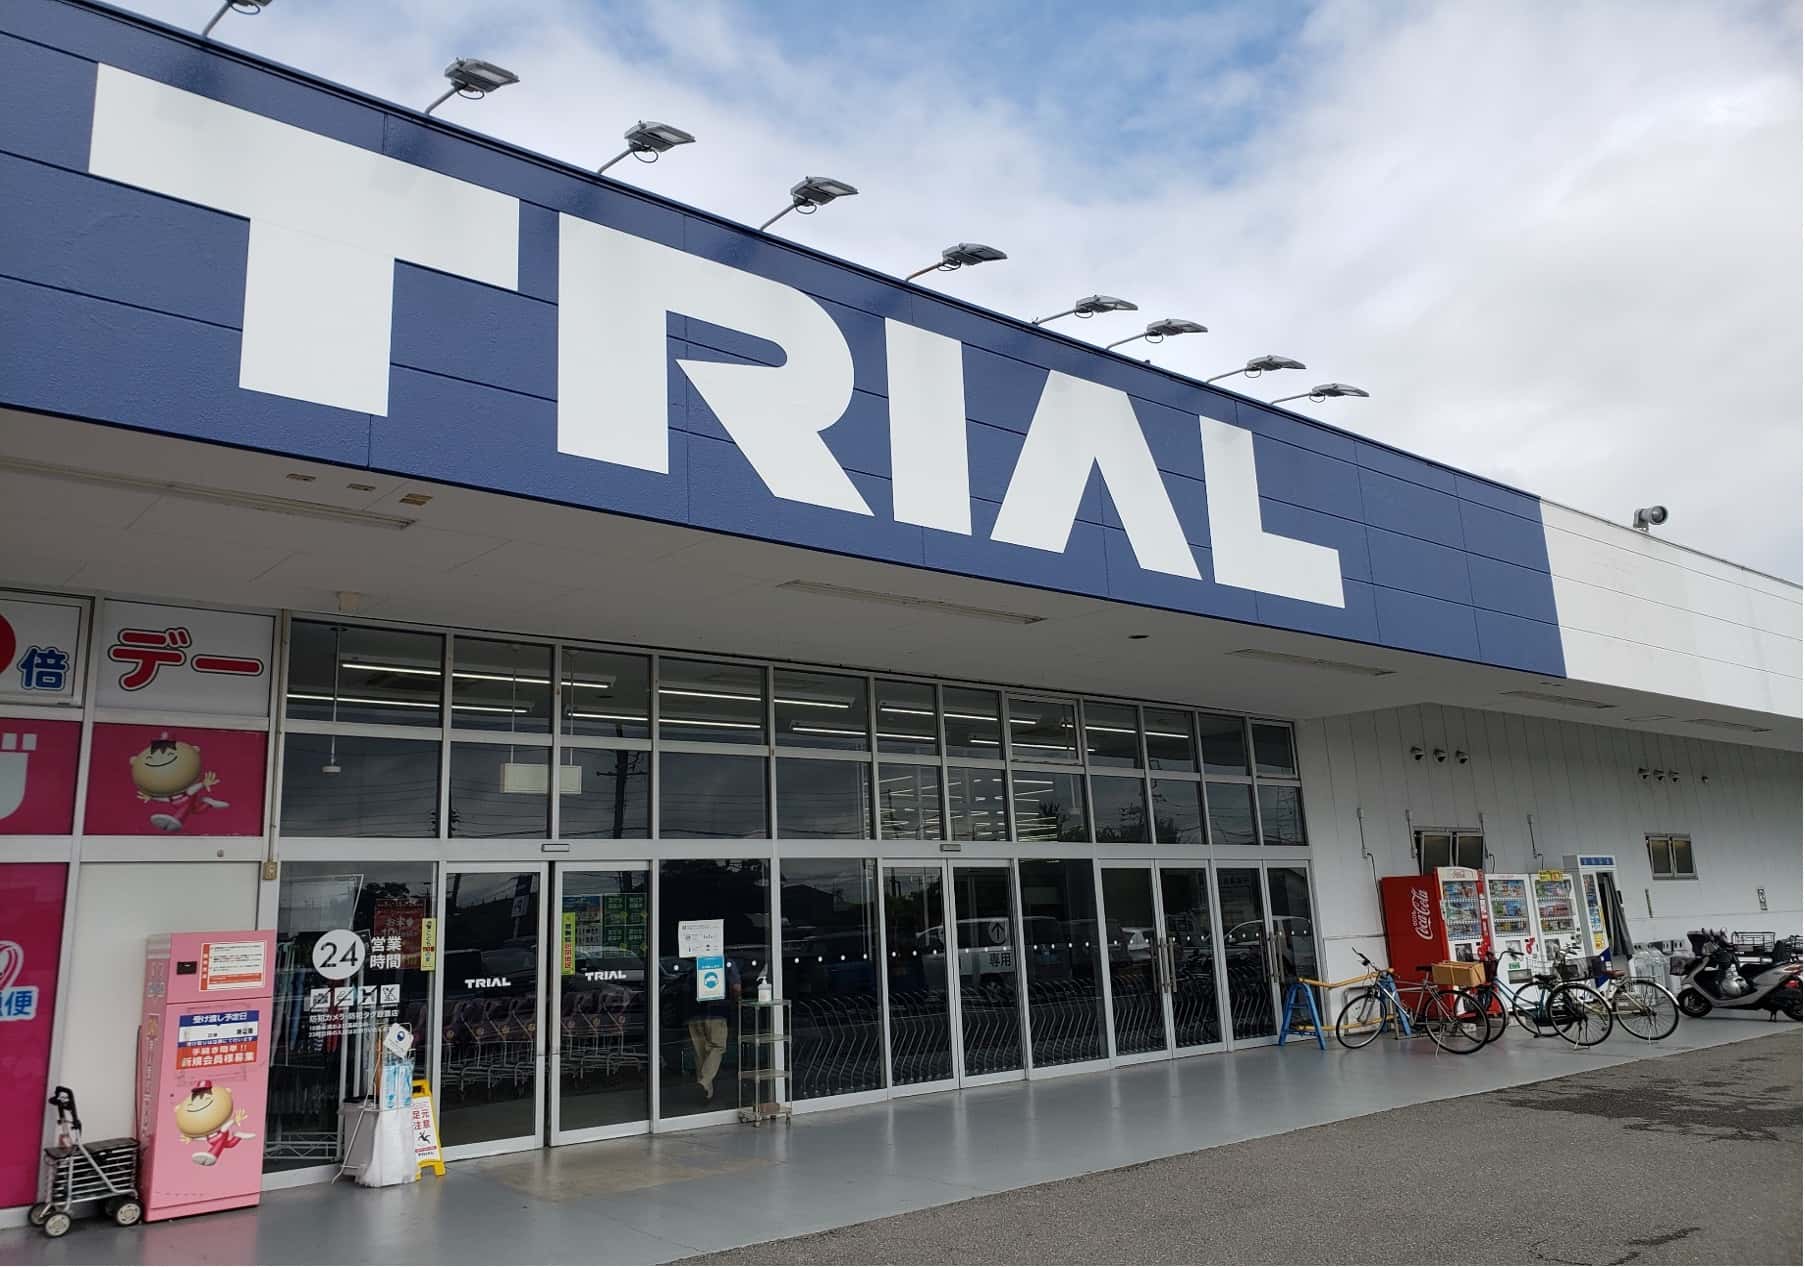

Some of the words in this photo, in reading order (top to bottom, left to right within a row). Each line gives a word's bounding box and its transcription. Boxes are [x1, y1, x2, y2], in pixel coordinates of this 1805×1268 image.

[88, 62, 1346, 609] TRIAL
[107, 627, 264, 691] デー
[319, 941, 359, 968] 24
[370, 935, 402, 952] 営業
[369, 953, 401, 970] 時間
[464, 976, 512, 989] TRIAL
[584, 970, 627, 982] TRIAL
[0, 990, 33, 1017] 便
